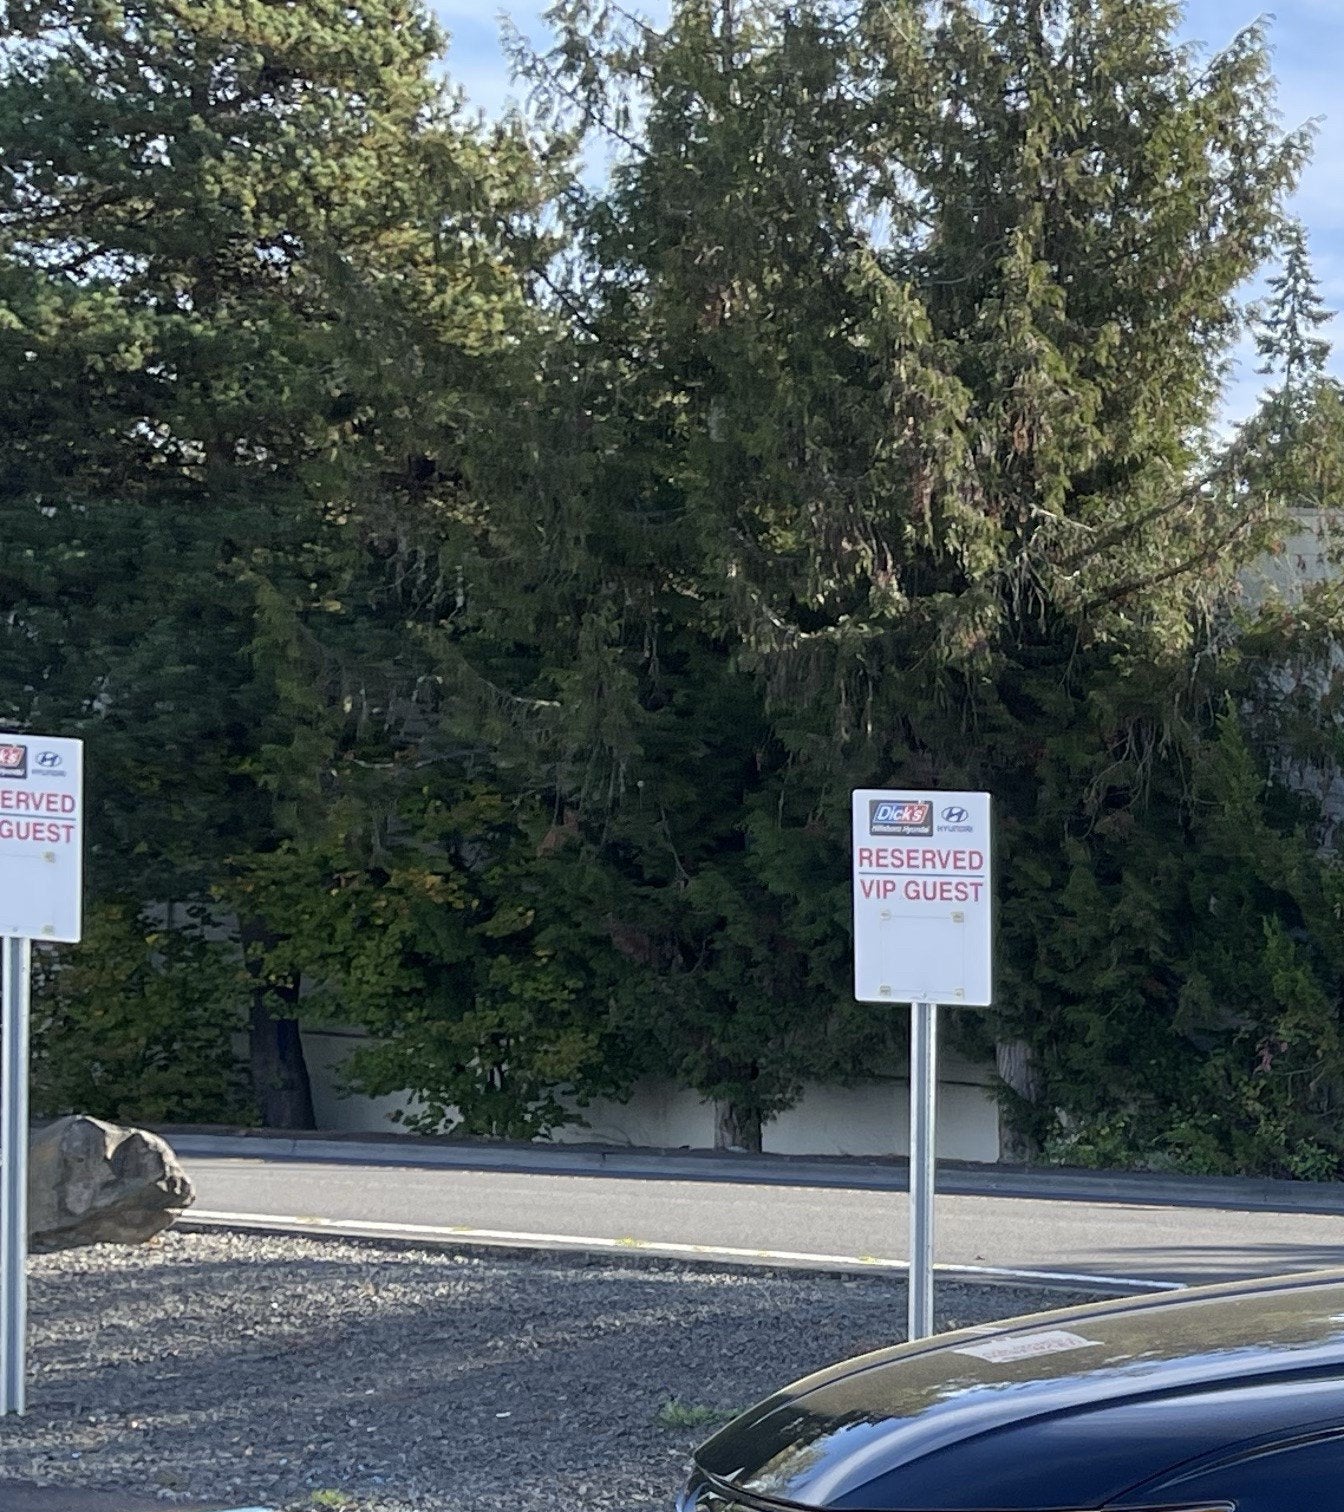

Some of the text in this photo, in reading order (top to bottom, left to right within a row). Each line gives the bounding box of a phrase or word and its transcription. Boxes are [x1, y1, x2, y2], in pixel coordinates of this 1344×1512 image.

[0, 789, 76, 814] ERVED
[0, 819, 75, 843] GUEST
[859, 847, 984, 871] RESERVED
[860, 879, 984, 903] VIP GUEST
